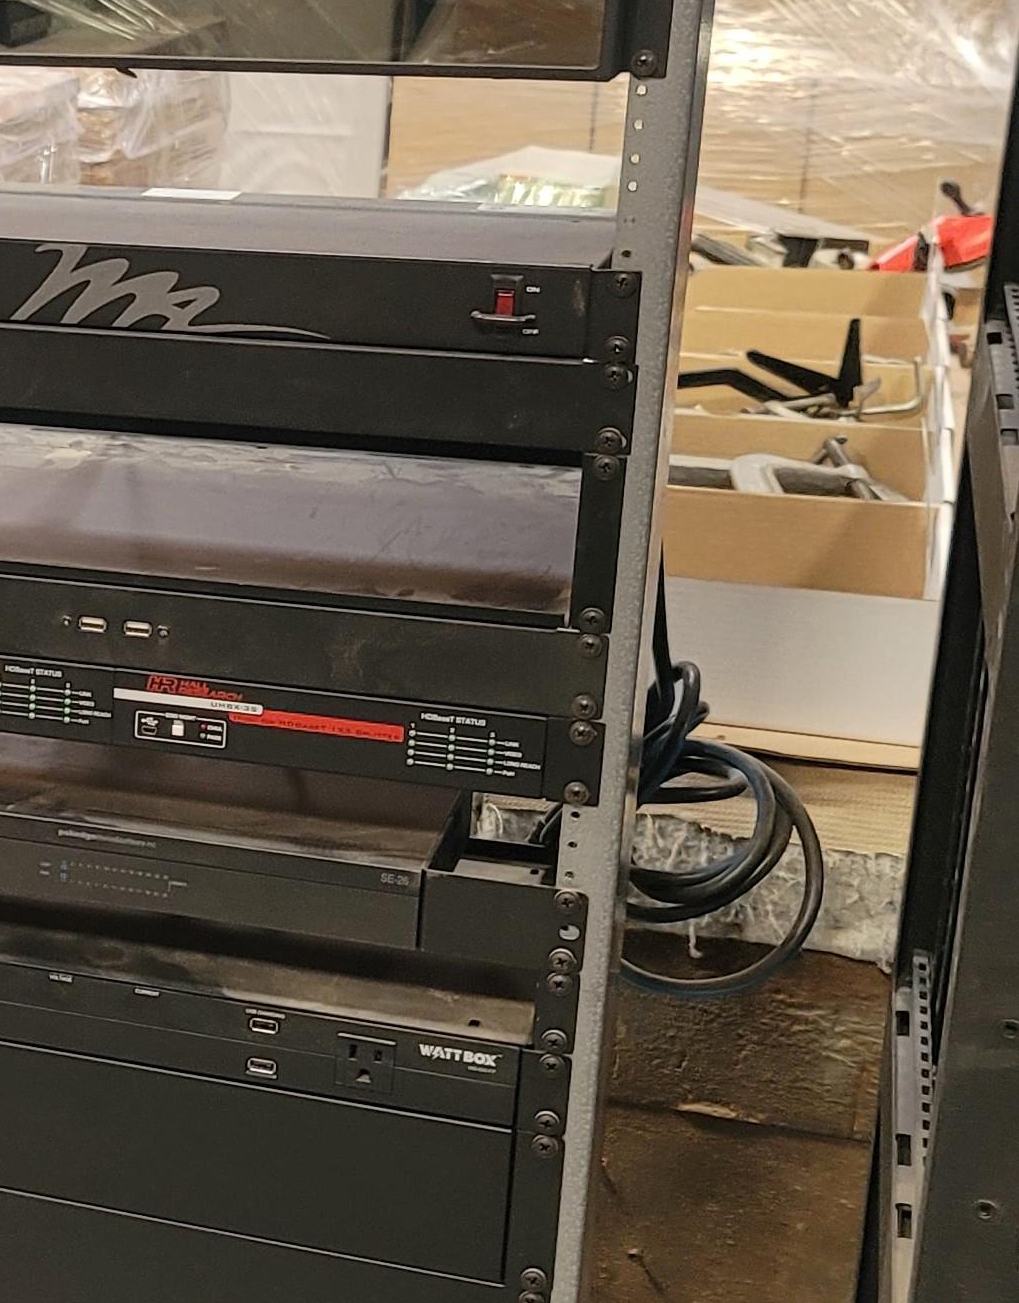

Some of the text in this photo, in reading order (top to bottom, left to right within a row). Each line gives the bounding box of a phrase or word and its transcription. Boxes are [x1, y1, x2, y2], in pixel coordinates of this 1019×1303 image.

[35, 667, 63, 678] STATUS
[180, 679, 209, 690] HALL
[455, 715, 487, 726] STATUS
